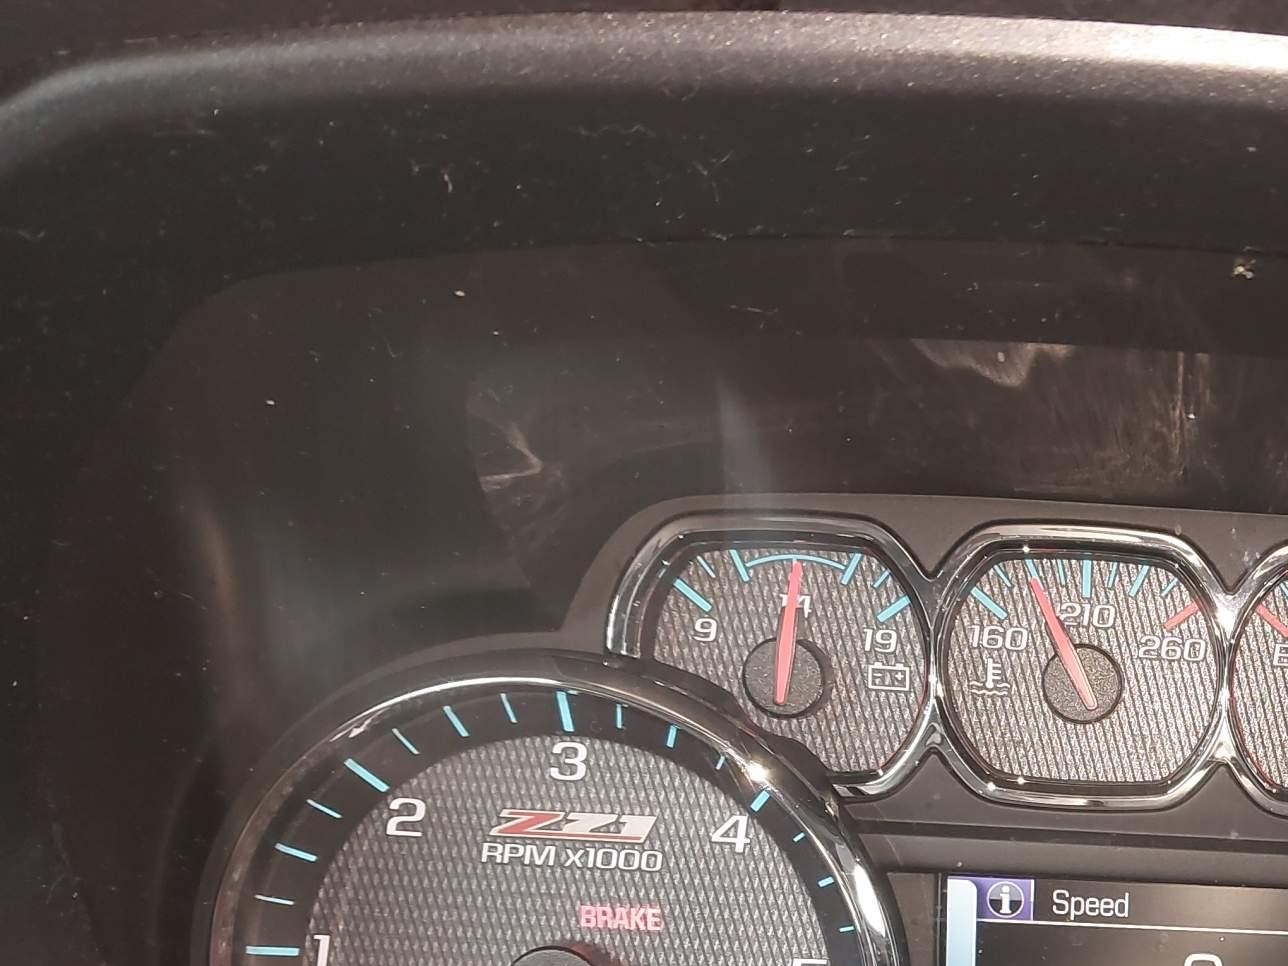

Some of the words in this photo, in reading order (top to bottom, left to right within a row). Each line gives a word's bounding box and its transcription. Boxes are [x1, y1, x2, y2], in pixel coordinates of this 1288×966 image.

[692, 617, 718, 643] 9
[1057, 602, 1116, 630] 210
[862, 628, 899, 654] 19
[969, 622, 1029, 652] 160
[1138, 634, 1206, 662] 260
[548, 741, 589, 782] 3
[385, 797, 426, 838] 2
[711, 814, 752, 853] 4
[481, 843, 557, 868] RPM
[579, 904, 663, 932] BRAKE
[1051, 889, 1130, 919] Speed
